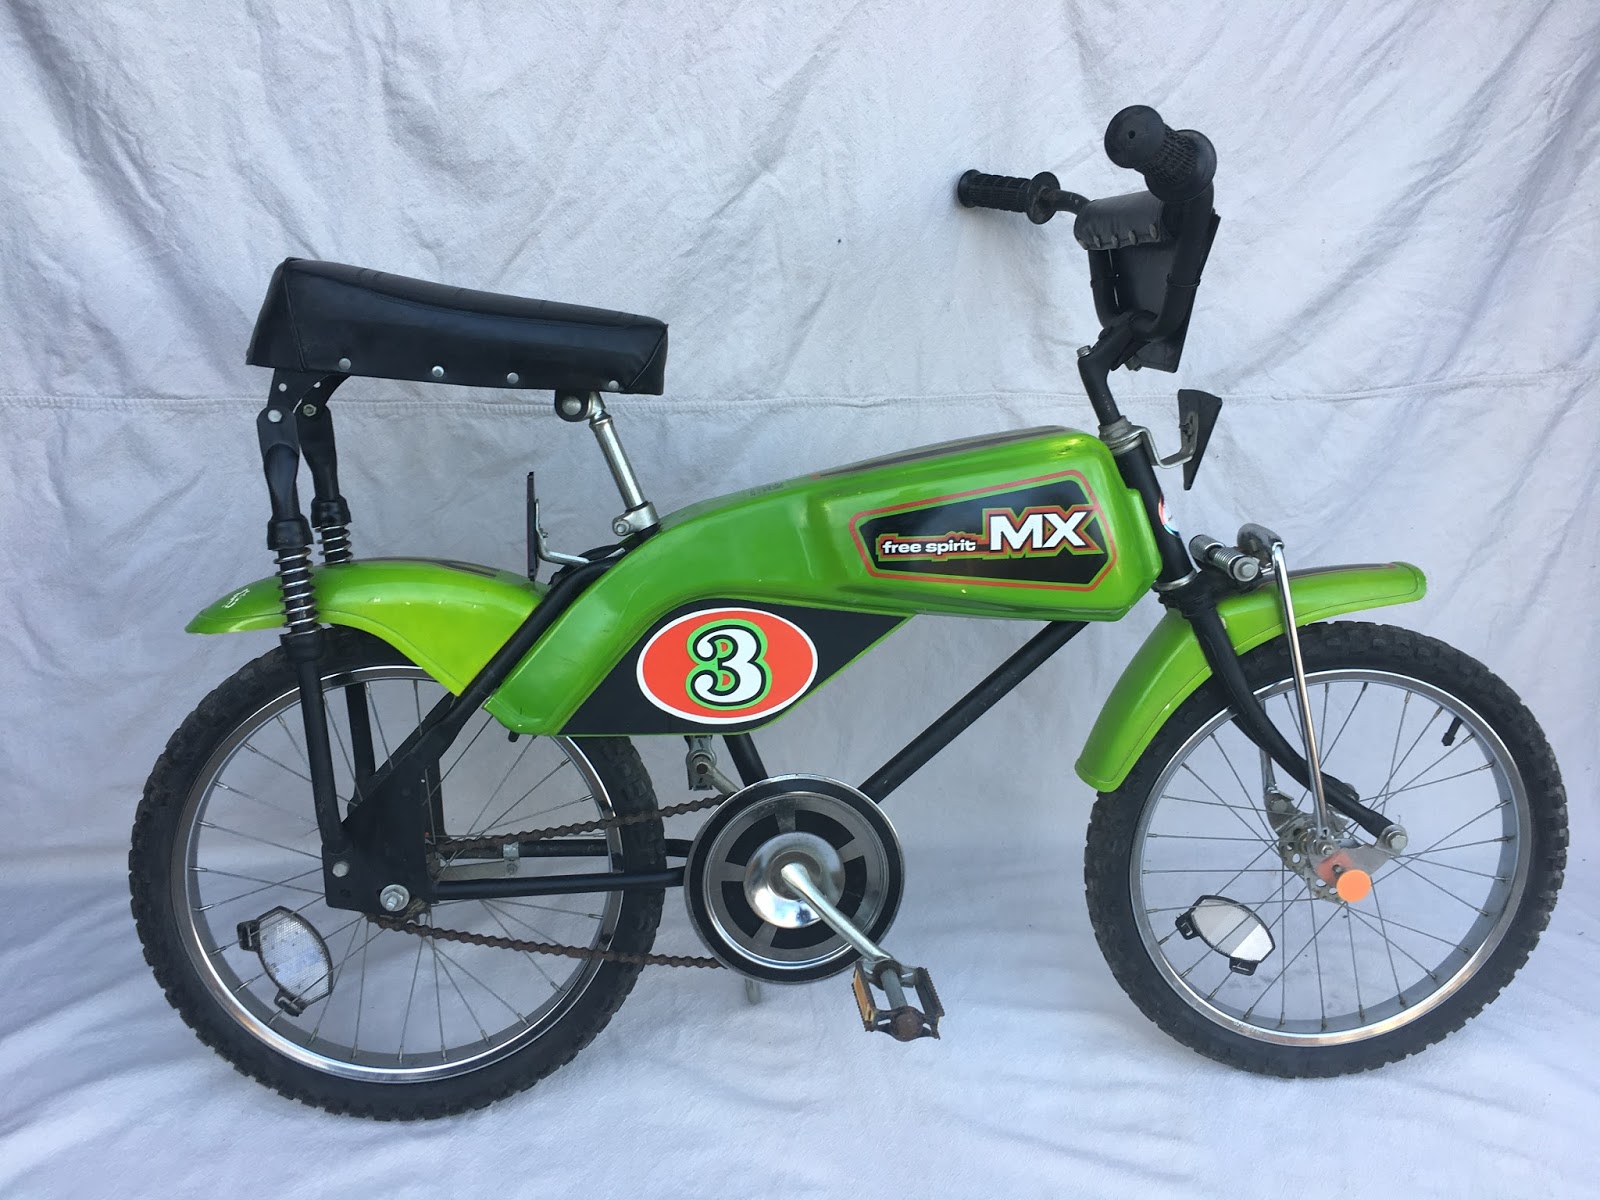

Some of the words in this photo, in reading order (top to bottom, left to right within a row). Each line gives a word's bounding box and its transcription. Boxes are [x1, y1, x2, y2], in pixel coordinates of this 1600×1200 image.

[881, 540, 922, 554] free
[925, 539, 976, 556] spirit
[989, 511, 1088, 551] MX
[692, 626, 765, 706] 3
